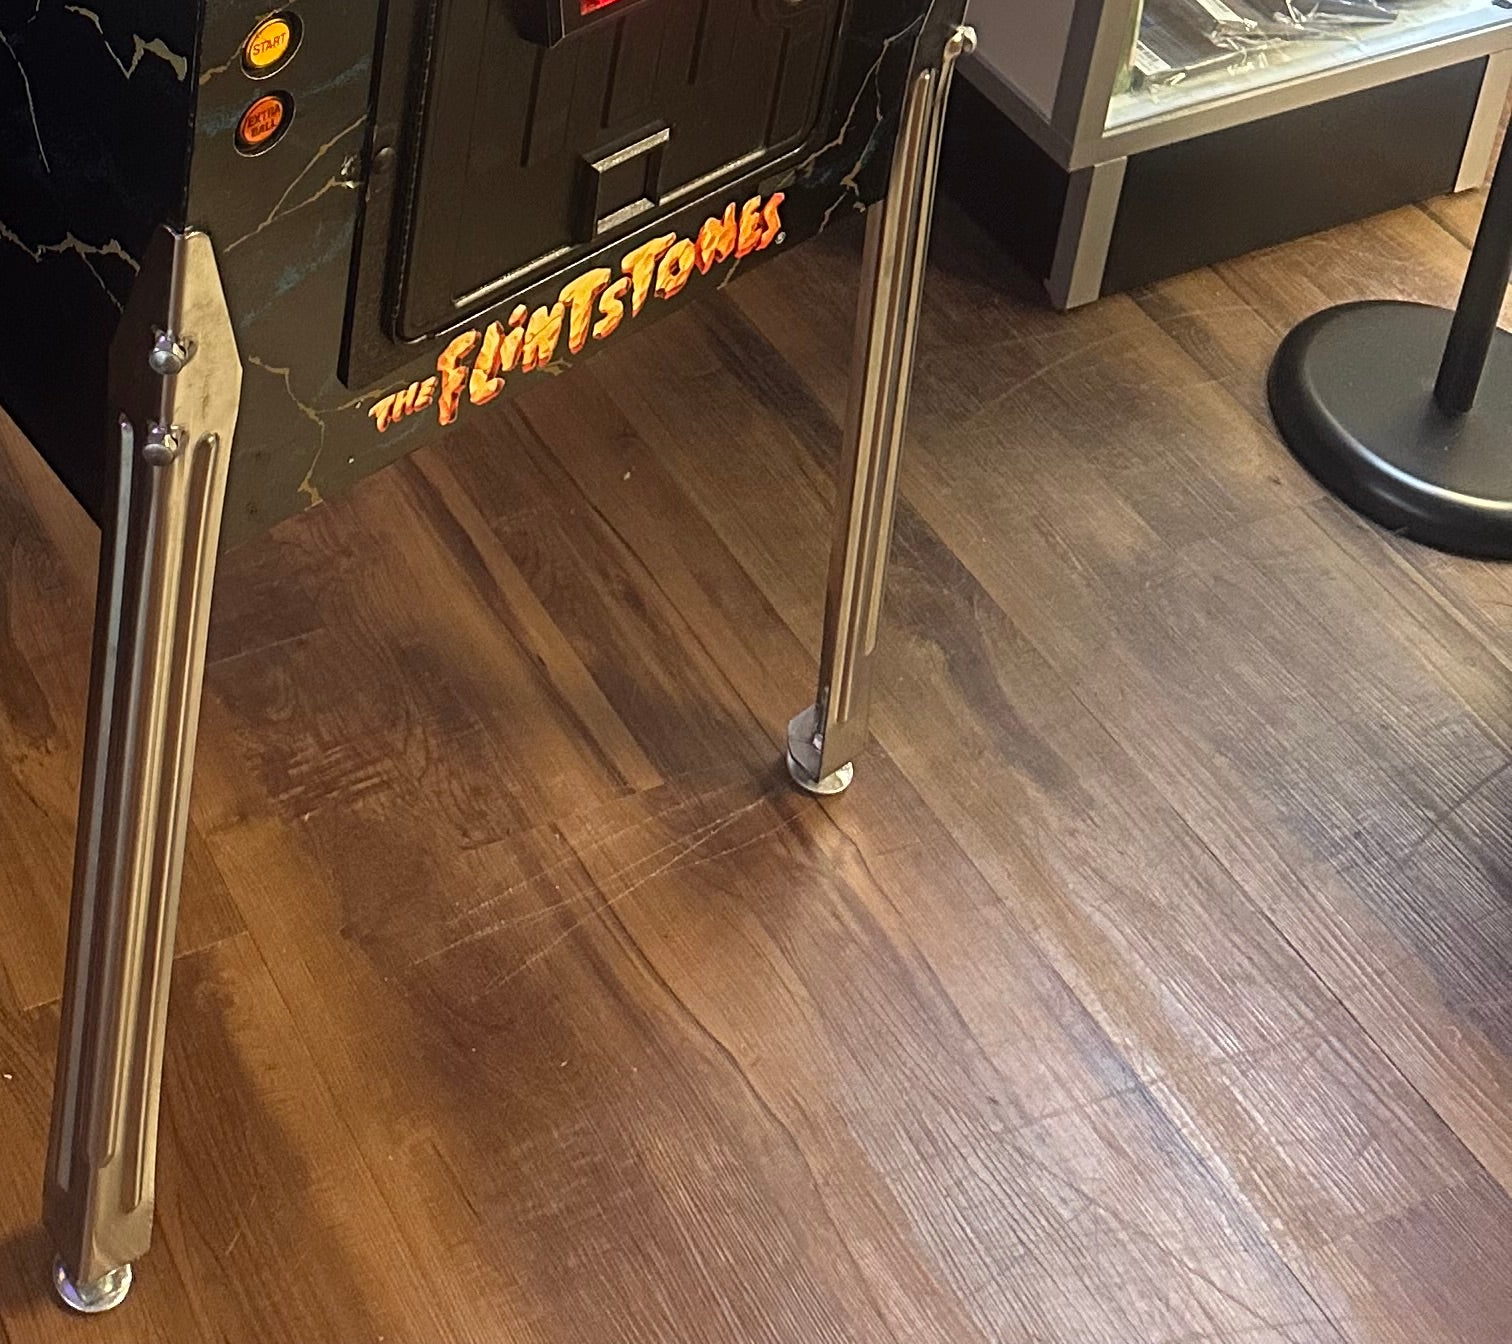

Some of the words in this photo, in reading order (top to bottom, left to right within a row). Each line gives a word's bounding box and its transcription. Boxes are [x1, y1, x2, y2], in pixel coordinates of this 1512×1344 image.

[252, 32, 287, 57] START
[247, 103, 281, 128] EXTRA
[250, 117, 277, 139] BALL
[368, 375, 439, 434] THE
[436, 191, 786, 428] FLINTSTONES
